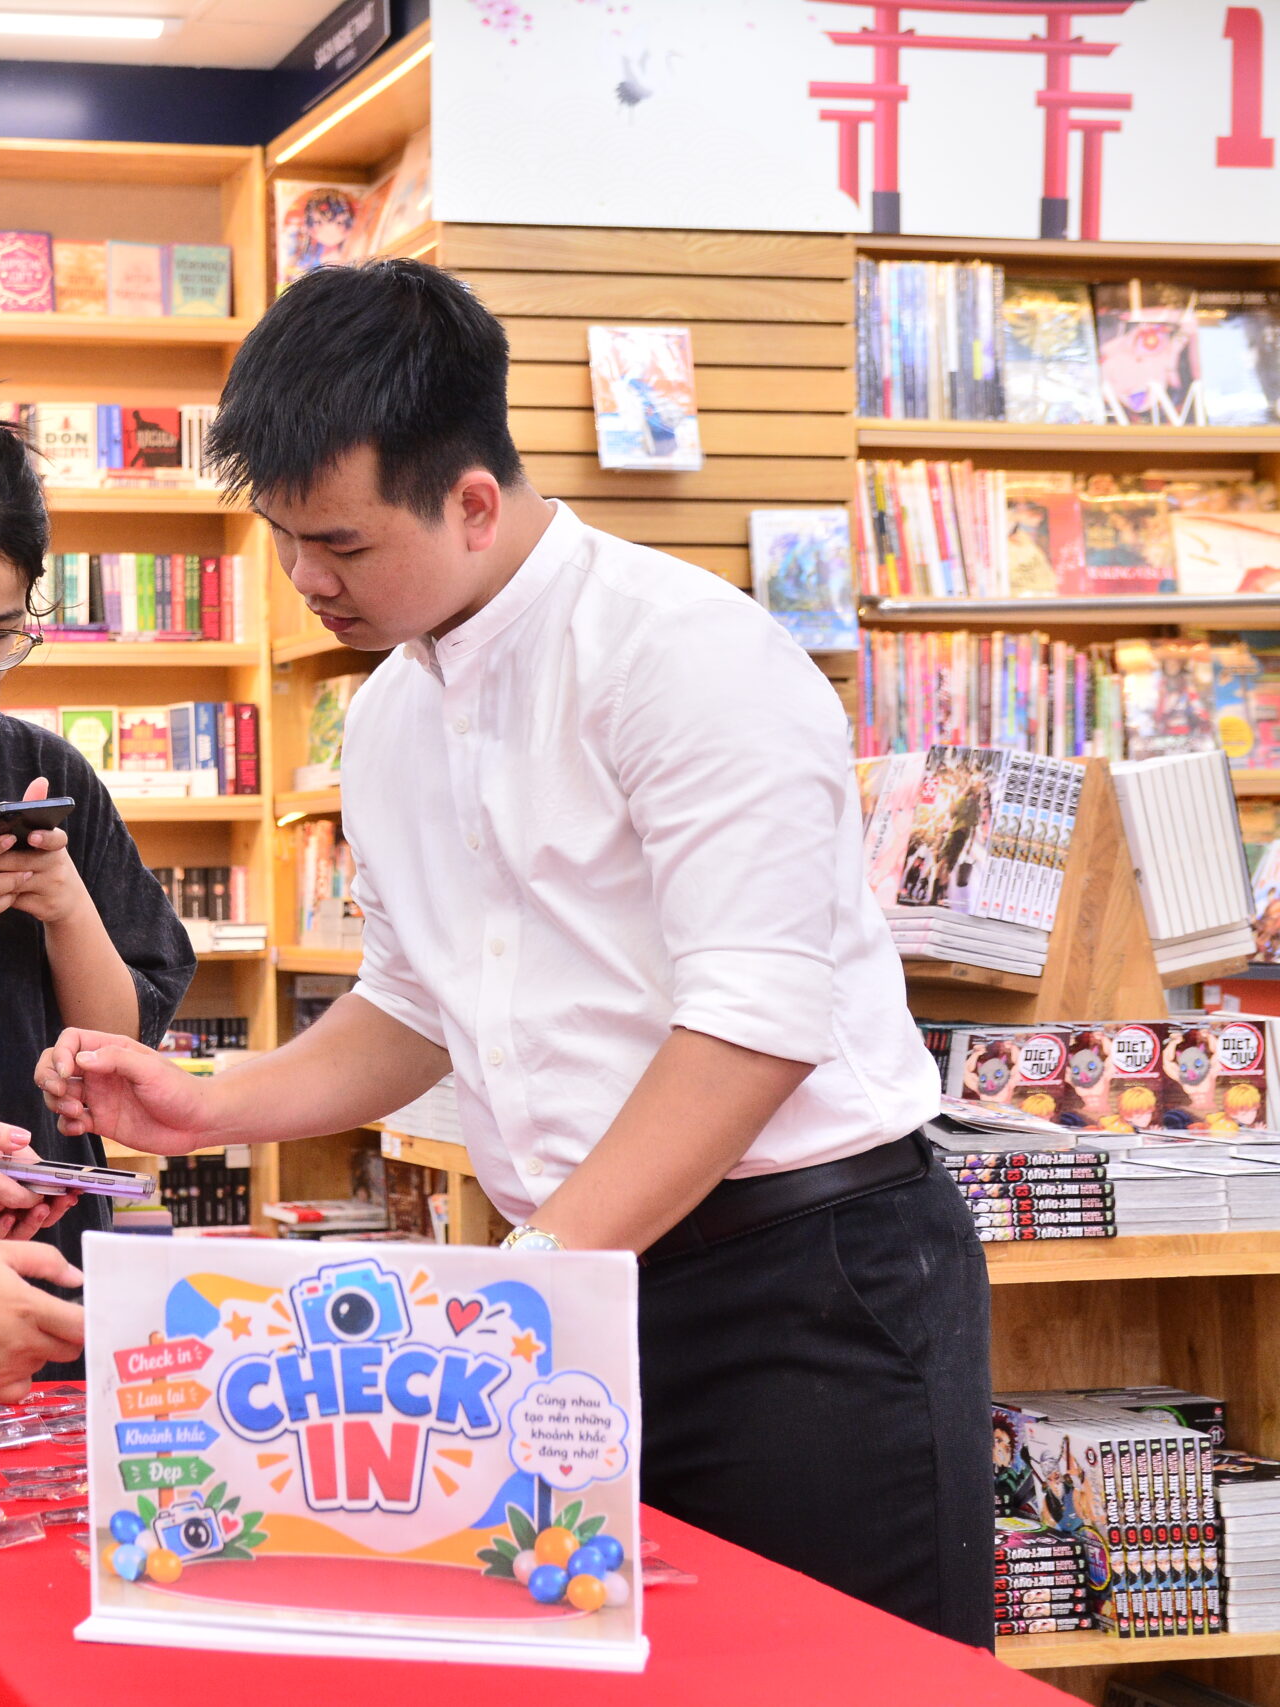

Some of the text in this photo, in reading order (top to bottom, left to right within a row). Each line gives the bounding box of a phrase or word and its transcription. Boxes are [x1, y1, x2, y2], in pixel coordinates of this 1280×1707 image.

[1216, 6, 1274, 168] 1
[45, 432, 88, 444] DON
[128, 1347, 192, 1374] Check in
[226, 1347, 503, 1432] CHECK
[138, 1388, 185, 1409] Lưu lại
[536, 1393, 601, 1409] Cùng nhau
[525, 1411, 611, 1429] tạo nên những
[125, 1424, 206, 1446] Khoảnh khắc
[531, 1427, 606, 1443] khoảnh khắc
[538, 1445, 599, 1461] đáng nhớ!
[306, 1421, 420, 1503] IN
[148, 1461, 183, 1485] Đẹp
[1111, 1530, 1120, 1543] 9
[1128, 1529, 1137, 1542] 9
[1143, 1529, 1152, 1541] 9
[1158, 1528, 1167, 1541] 9
[1173, 1527, 1182, 1541] 9
[1189, 1526, 1198, 1540] 9
[1205, 1526, 1215, 1540] 9
